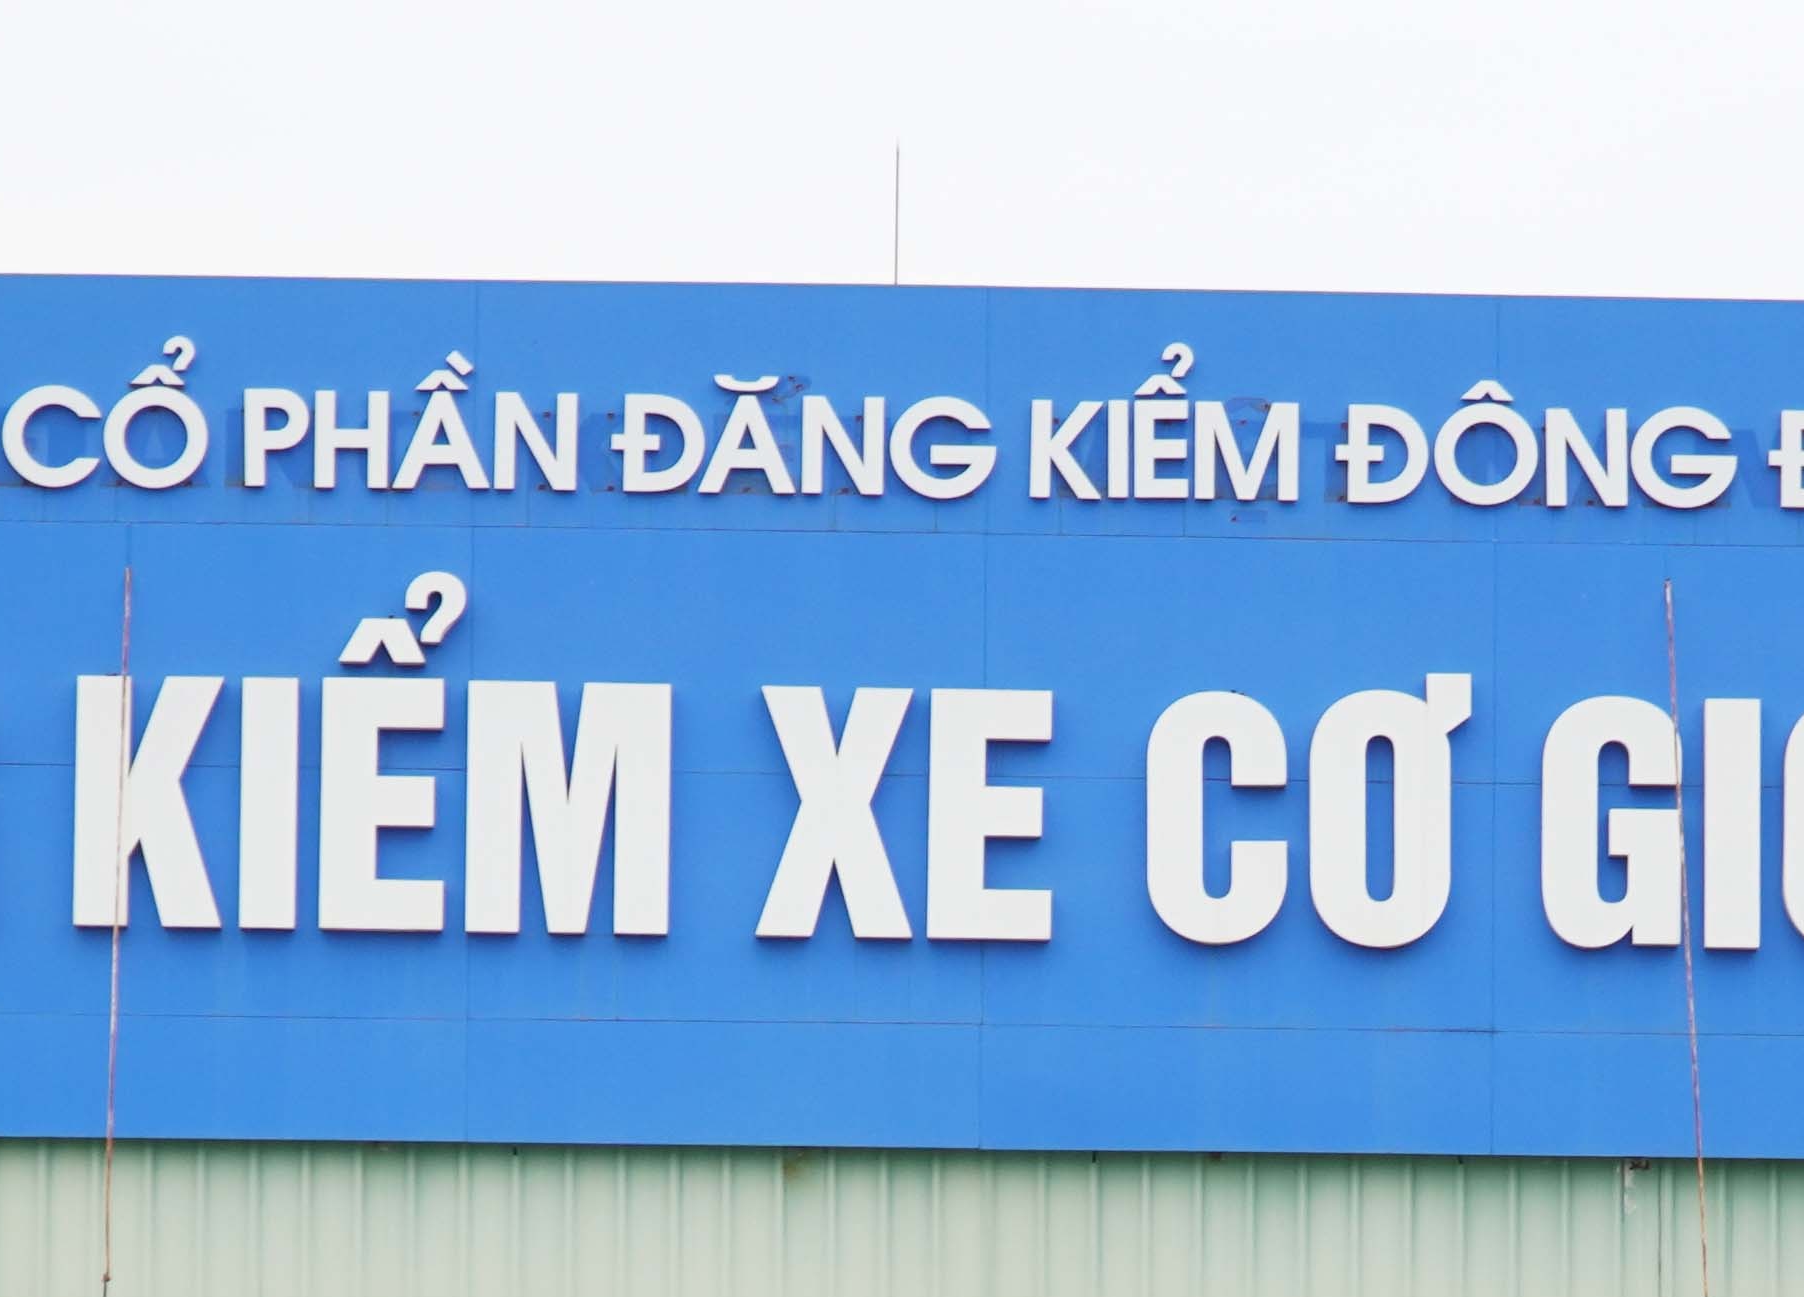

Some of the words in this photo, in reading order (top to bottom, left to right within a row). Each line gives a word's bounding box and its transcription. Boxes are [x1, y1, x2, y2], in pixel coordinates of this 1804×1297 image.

[3, 335, 209, 489] CỔ
[244, 351, 579, 491] PHẦN
[612, 374, 997, 499] ĐĂNG
[1030, 342, 1300, 501] KIỂM
[1336, 379, 1738, 509] ĐÔNG
[73, 571, 672, 935] KIỂM
[756, 685, 1053, 941] XE
[1147, 672, 1472, 948] CƠ
